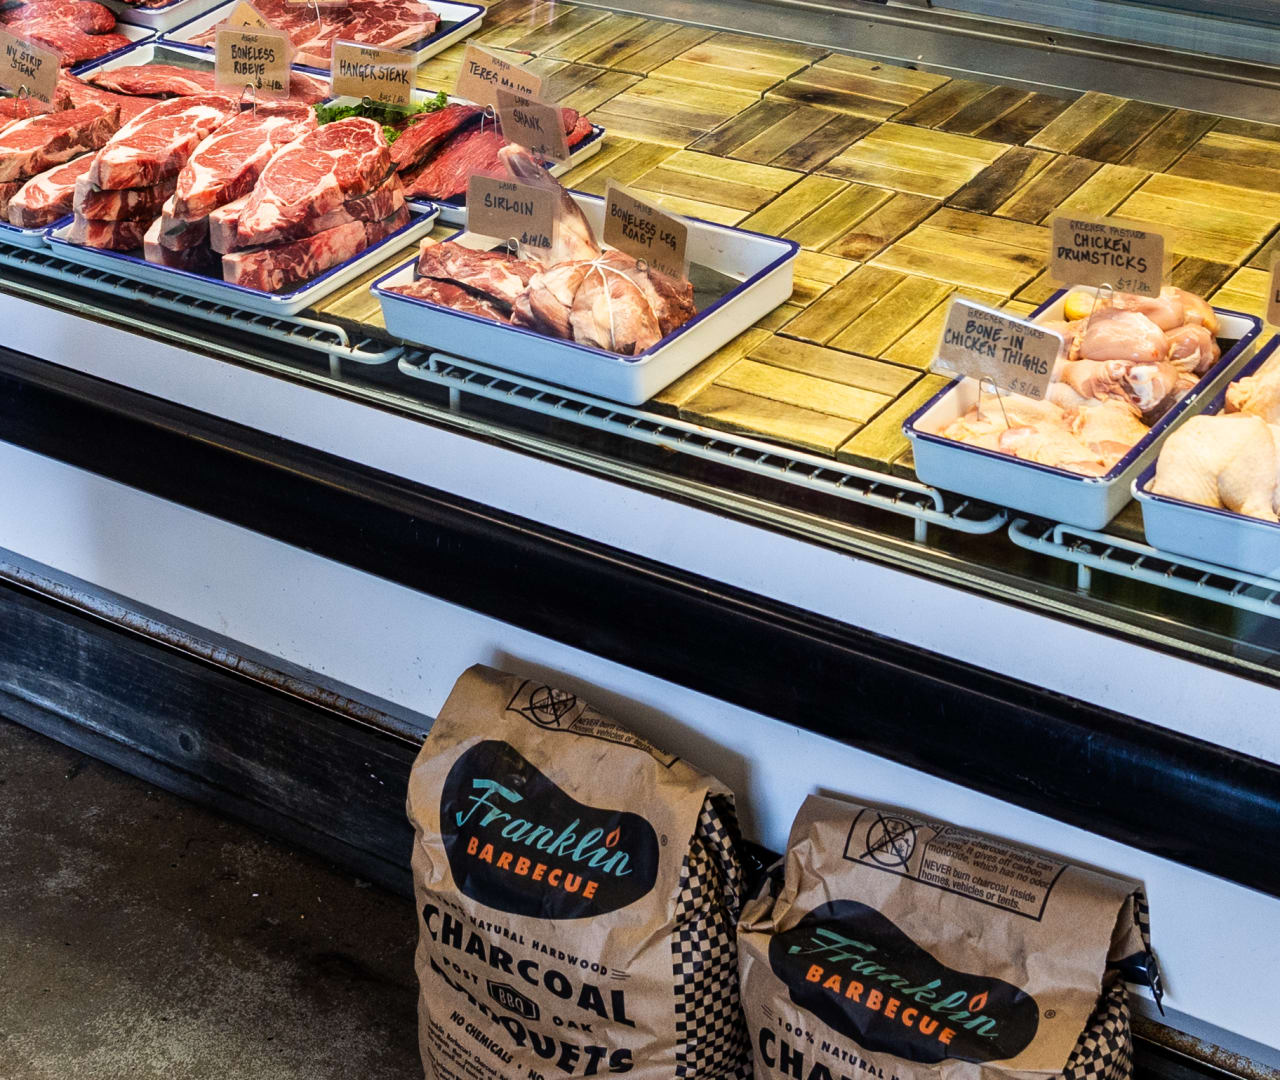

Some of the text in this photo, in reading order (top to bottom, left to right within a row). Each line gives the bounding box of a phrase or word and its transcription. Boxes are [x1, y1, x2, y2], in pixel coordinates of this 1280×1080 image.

[6, 45, 43, 71] NY STRIP
[231, 44, 275, 63] BONELESS
[11, 59, 36, 80] STEAK
[233, 60, 265, 78] RIBEYE
[339, 60, 410, 85] HANGER STEAK
[469, 60, 498, 85] TERES
[513, 108, 544, 134] SHANK
[498, 182, 518, 192] LAMB
[484, 193, 534, 216] SIRLOIN
[611, 204, 677, 251] BONELESS LEG
[622, 226, 654, 248] ROAST
[1070, 220, 1106, 234] GREENER
[1074, 233, 1131, 253] CHICKEN
[1057, 246, 1148, 273] DRUMSTICKS
[967, 309, 1004, 326] GREENER
[965, 320, 1024, 350] BONE-IN
[944, 329, 1048, 376] CHICKEN THIGHS
[455, 778, 633, 877] Franklin
[971, 840, 1009, 858] charcoal
[466, 836, 599, 900] BARBECUE
[928, 843, 970, 865] monoxide,
[972, 858, 998, 872] which
[999, 867, 1015, 878] has
[1016, 873, 1028, 882] no
[974, 850, 997, 863] gives
[998, 857, 1011, 866] off
[1012, 861, 1042, 876] carbon
[921, 869, 1020, 909] homes, vehicles or tents.
[924, 859, 1037, 904] NEVER burn charcoal inside
[470, 915, 608, 976] NATURAL HARDWOOD
[422, 903, 636, 1029] CHARCOAL
[443, 956, 478, 985] POST
[788, 927, 998, 1039] Franklin
[498, 988, 524, 1012] BBQ
[805, 964, 957, 1046] BARBECUE
[430, 955, 635, 1076] QUETS
[552, 1016, 593, 1033] OAK
[450, 1010, 465, 1027] NO
[464, 1023, 514, 1064] CHEMICALS
[777, 1016, 885, 1080] 100% NATURAL
